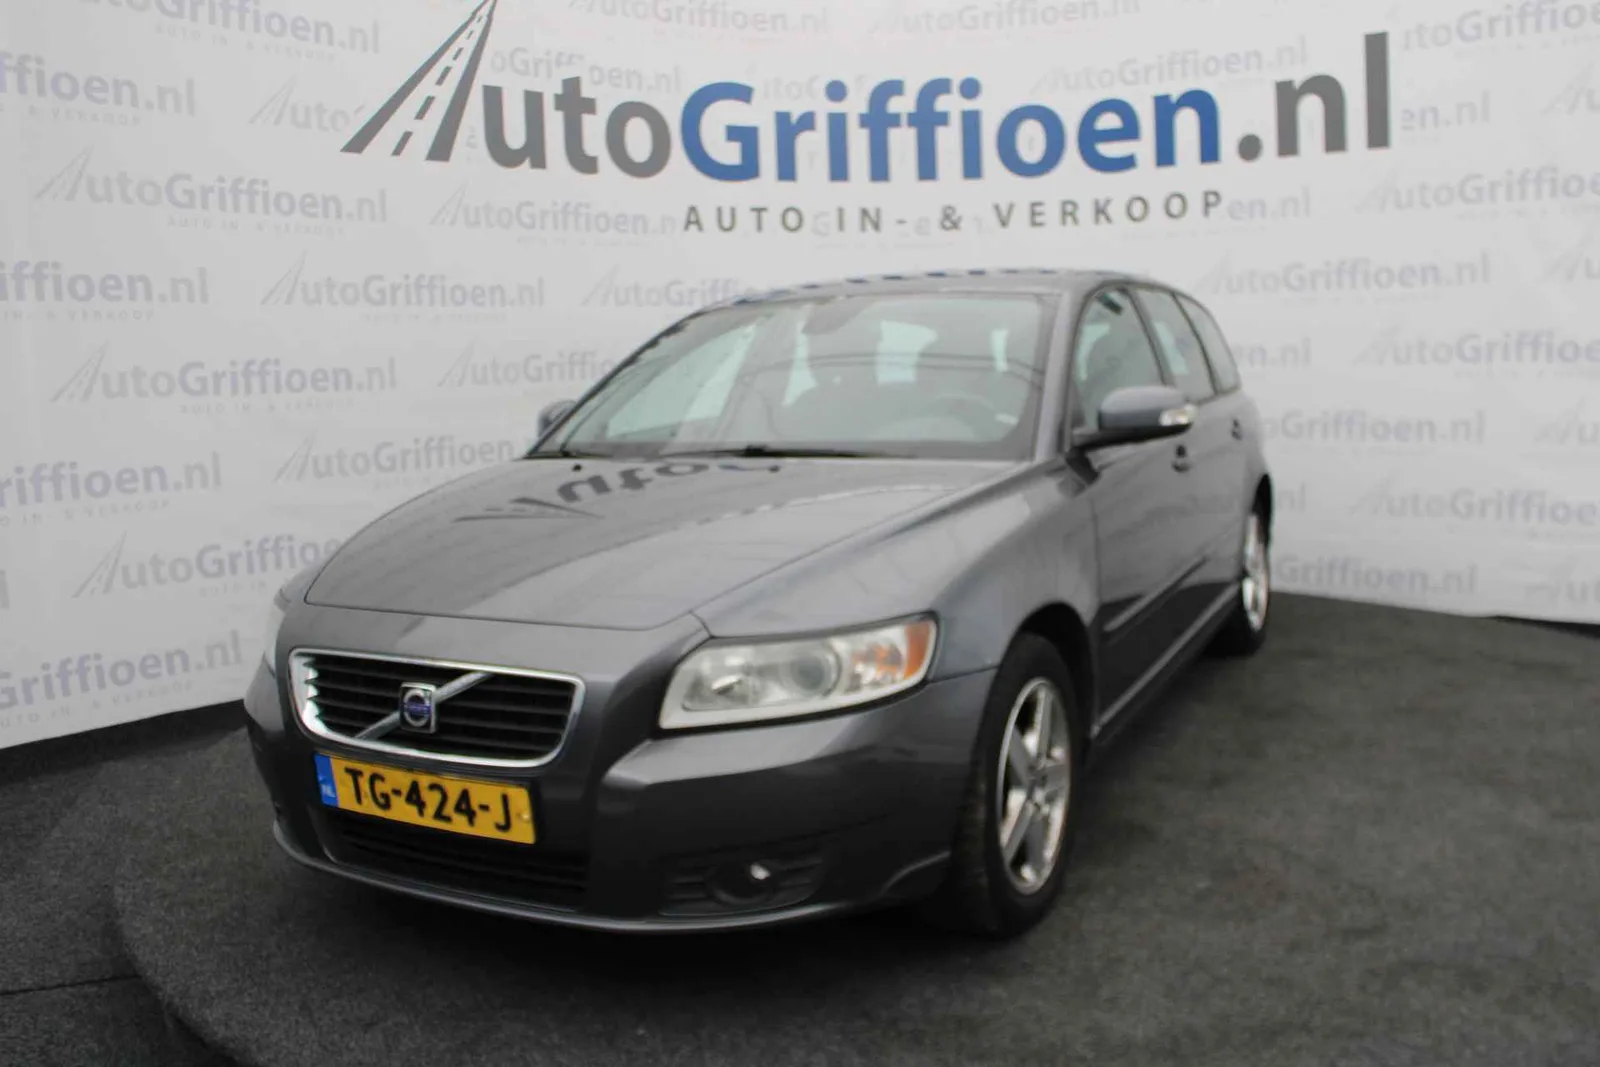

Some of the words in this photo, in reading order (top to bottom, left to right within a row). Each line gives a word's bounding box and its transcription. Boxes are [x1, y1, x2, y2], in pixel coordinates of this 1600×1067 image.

[683, 204, 804, 233] AUTO
[939, 204, 962, 232] &
[993, 189, 1222, 229] VERKOOP
[49, 339, 397, 403] AutoGriffioen.nl
[345, 767, 512, 832] TG-424-J
